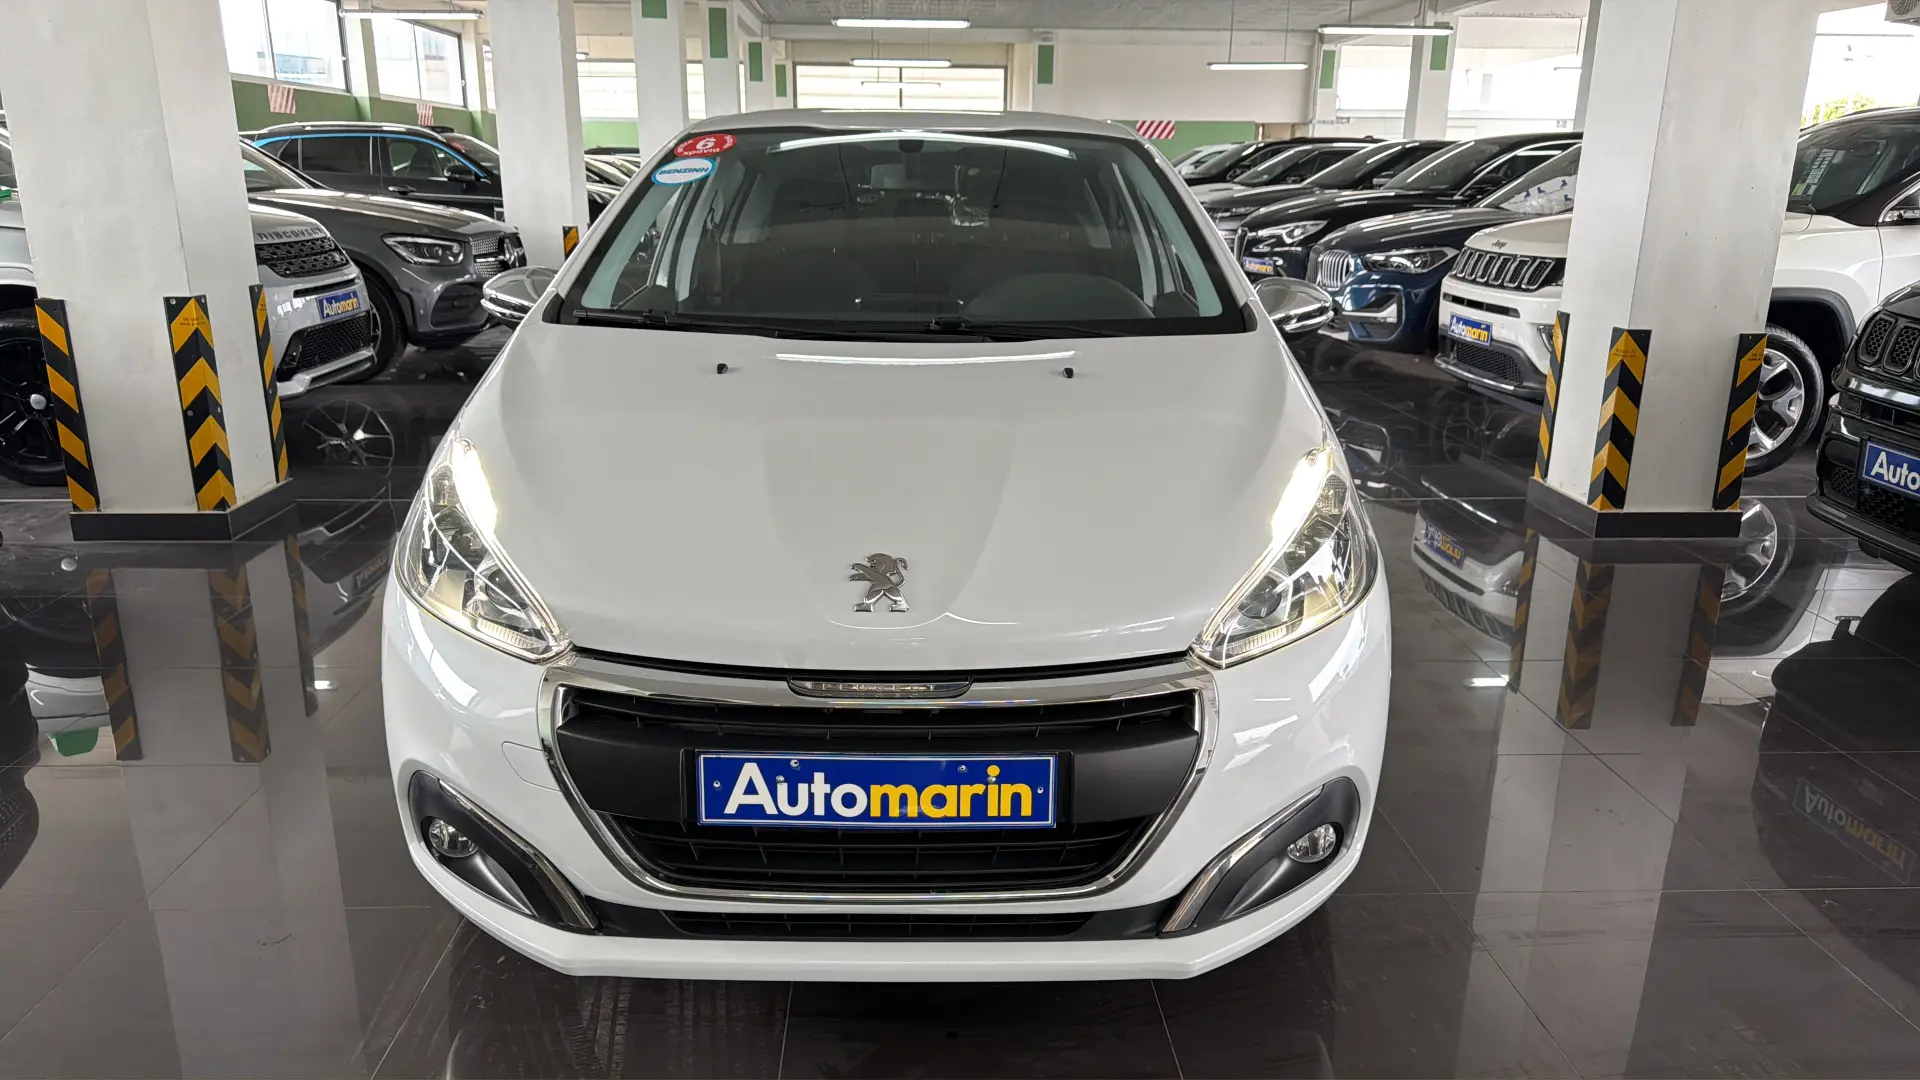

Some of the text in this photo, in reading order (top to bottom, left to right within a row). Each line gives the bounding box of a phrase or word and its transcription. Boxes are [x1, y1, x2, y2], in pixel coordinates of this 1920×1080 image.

[695, 136, 717, 150] 6
[322, 292, 359, 318] Automarin
[1450, 316, 1489, 342] Automarin
[723, 762, 1033, 818] Automarin
